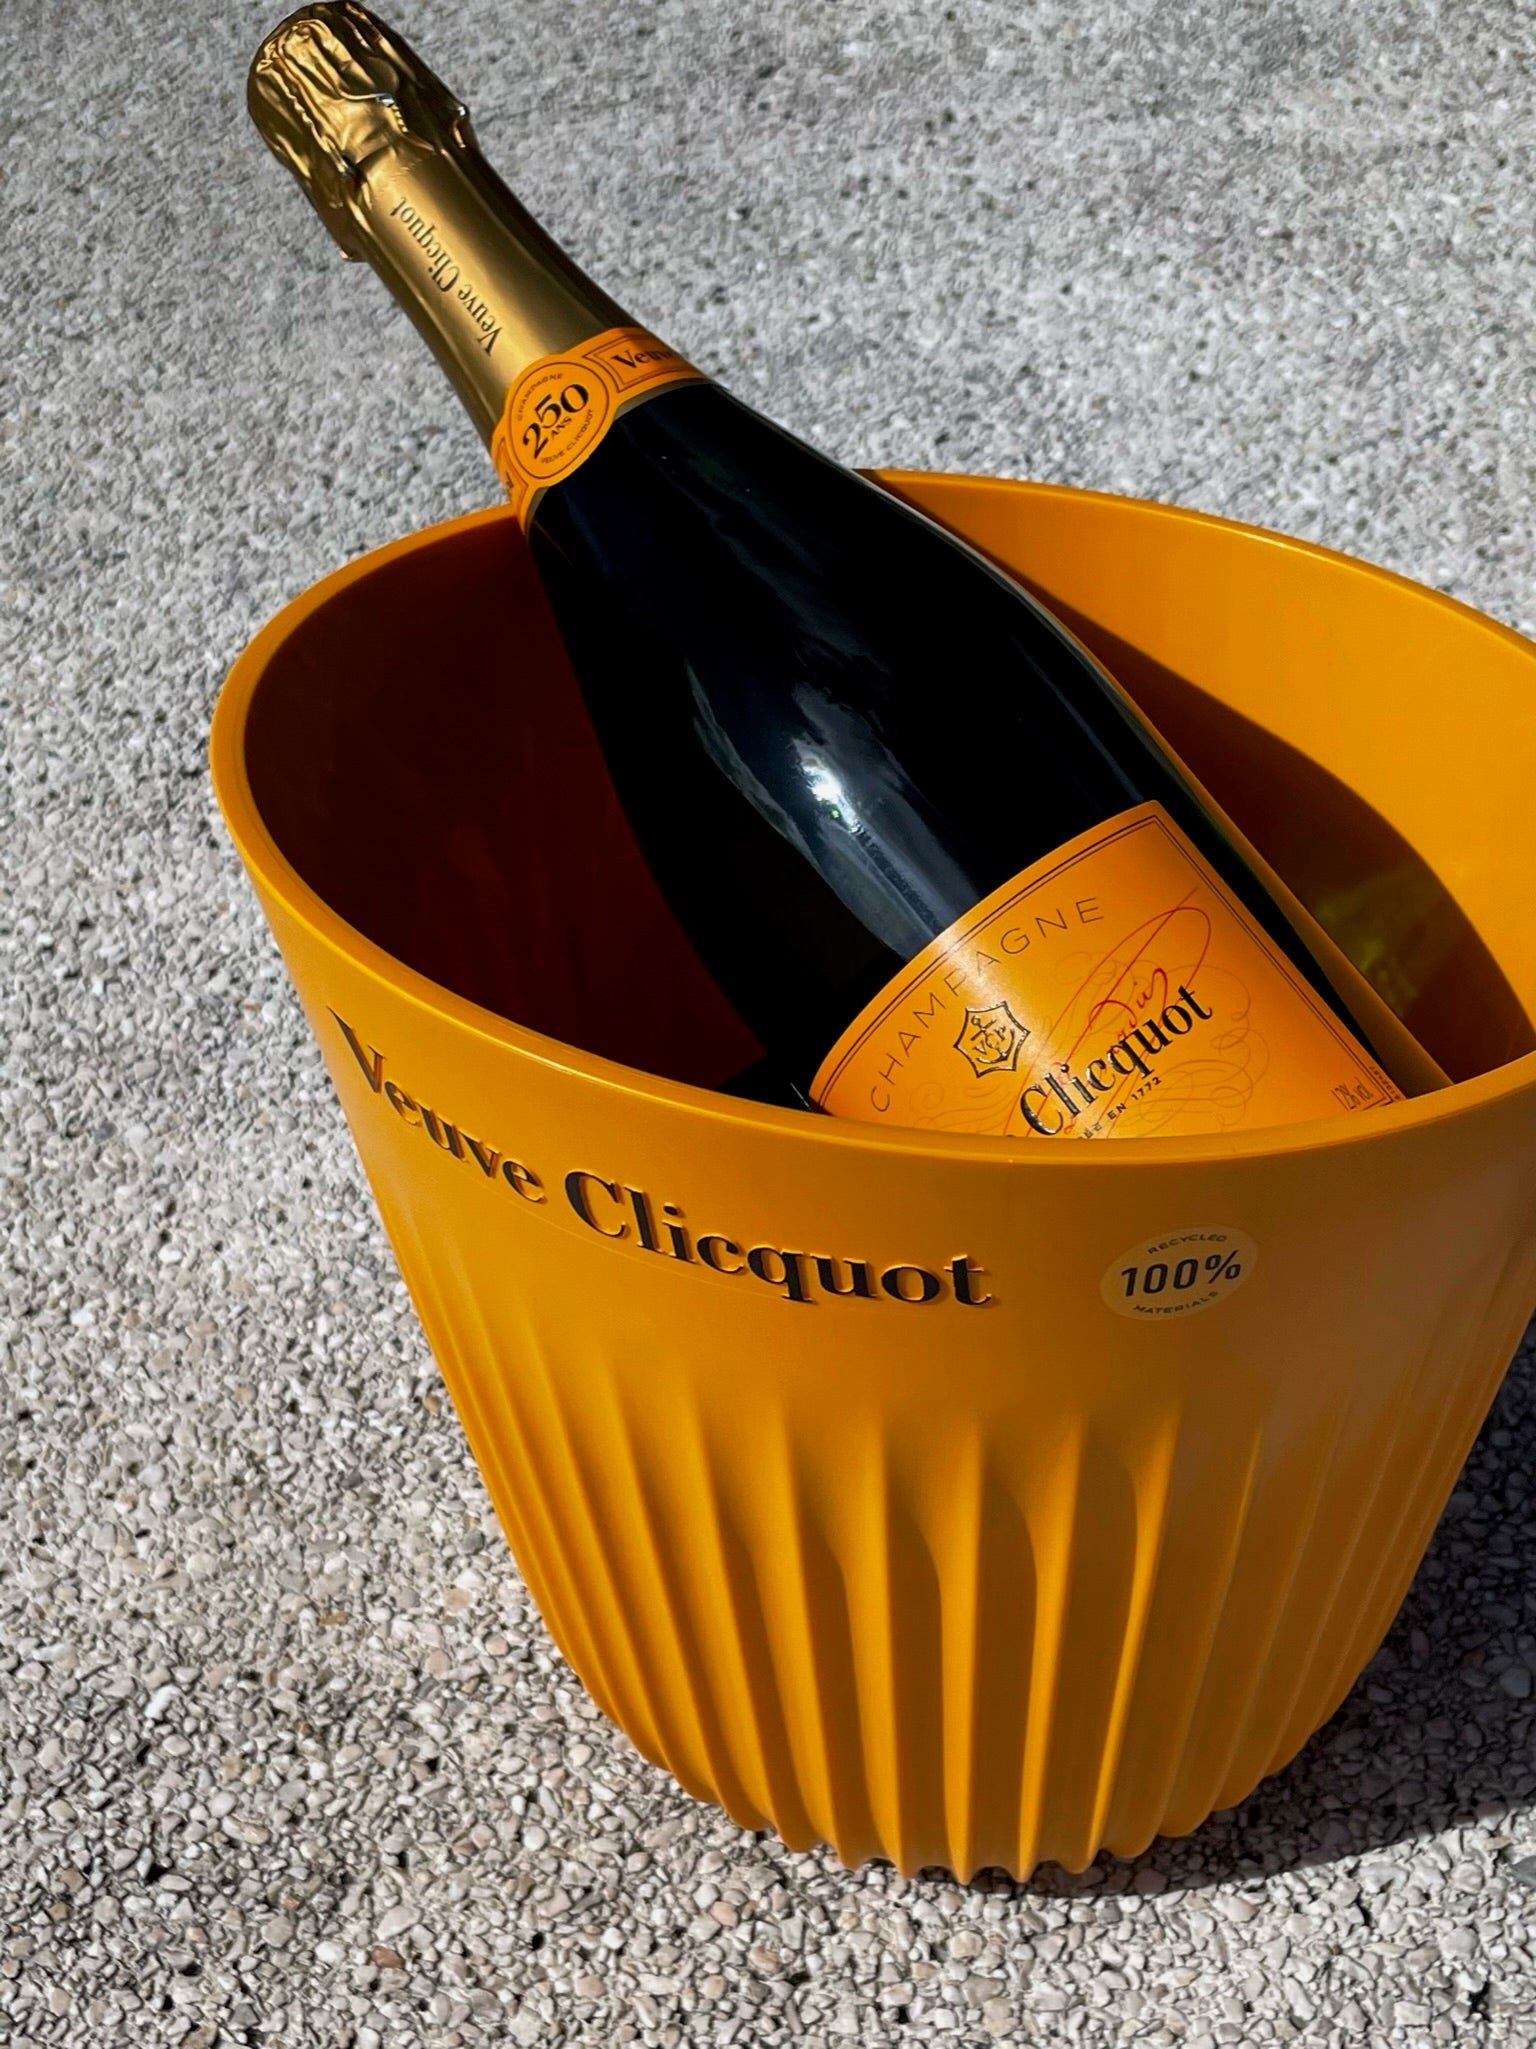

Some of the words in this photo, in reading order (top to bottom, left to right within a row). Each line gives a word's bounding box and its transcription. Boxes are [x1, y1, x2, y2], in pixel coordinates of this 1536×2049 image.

[390, 197, 460, 293] Clicquot
[457, 284, 503, 357] Veuve
[517, 373, 564, 421] CHAMPAGNE
[522, 384, 589, 460] 250
[541, 451, 565, 464] VEUVE
[566, 408, 593, 450] CLICQUOT
[551, 417, 572, 440] ANS
[870, 897, 1104, 1113] CHAMPAGNE
[1020, 985, 1213, 1136] Clicquot
[1107, 1102, 1127, 1120] EN
[1131, 1076, 1162, 1101] 1772
[327, 1005, 546, 1205] Veuve
[563, 1169, 994, 1306] Clicquot
[1147, 1234, 1228, 1254] RECYCLED
[1121, 1249, 1241, 1297] 100%
[1133, 1291, 1219, 1314] MATERIALS
